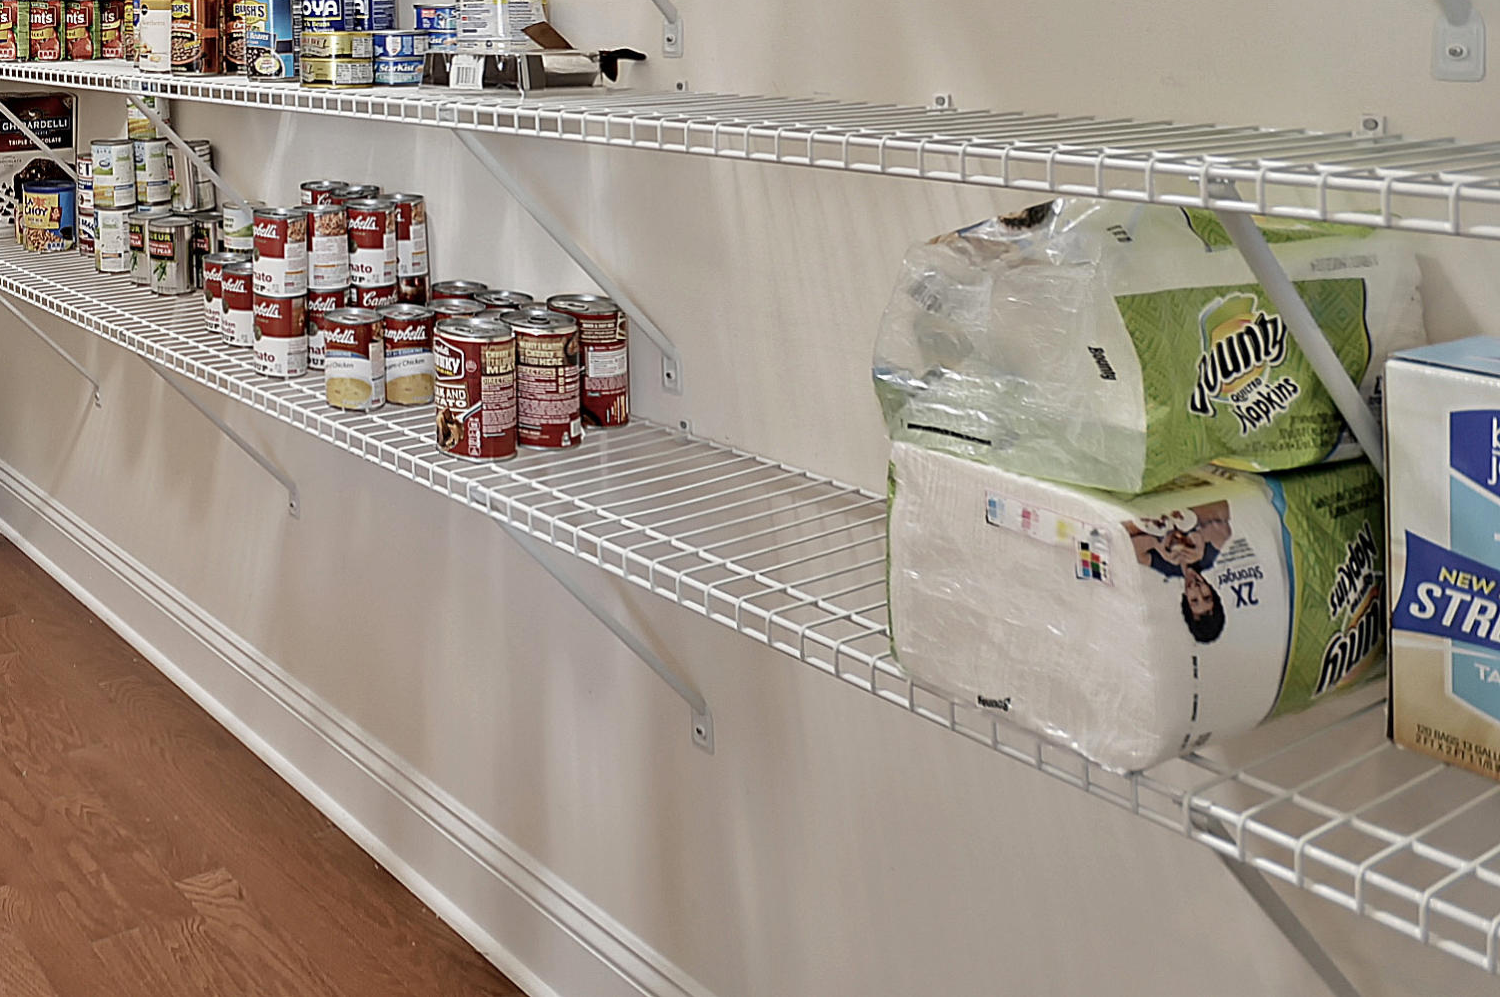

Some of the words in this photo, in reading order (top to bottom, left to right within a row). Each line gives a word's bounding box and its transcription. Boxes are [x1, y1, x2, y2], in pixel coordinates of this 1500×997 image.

[302, 0, 339, 15] OYA
[66, 12, 85, 24] nt's
[379, 64, 414, 73] StarKist
[78, 160, 92, 176] ET
[25, 206, 49, 217] CHOY
[253, 223, 280, 239] pbell's
[349, 216, 379, 230] pbell's
[253, 303, 282, 319] pbell's
[385, 326, 428, 341] ampbell's
[402, 358, 425, 366] Chicken
[446, 388, 466, 400] AND
[436, 397, 467, 408] TATO
[1233, 378, 1299, 434] Napkins
[1218, 565, 1263, 585] Stronger
[1331, 522, 1377, 617] Napkins
[1439, 566, 1496, 595] NEW
[1230, 581, 1259, 608] 2X
[1316, 603, 1379, 694] unty
[1434, 730, 1460, 744] BAGS
[1463, 740, 1473, 751] 13
